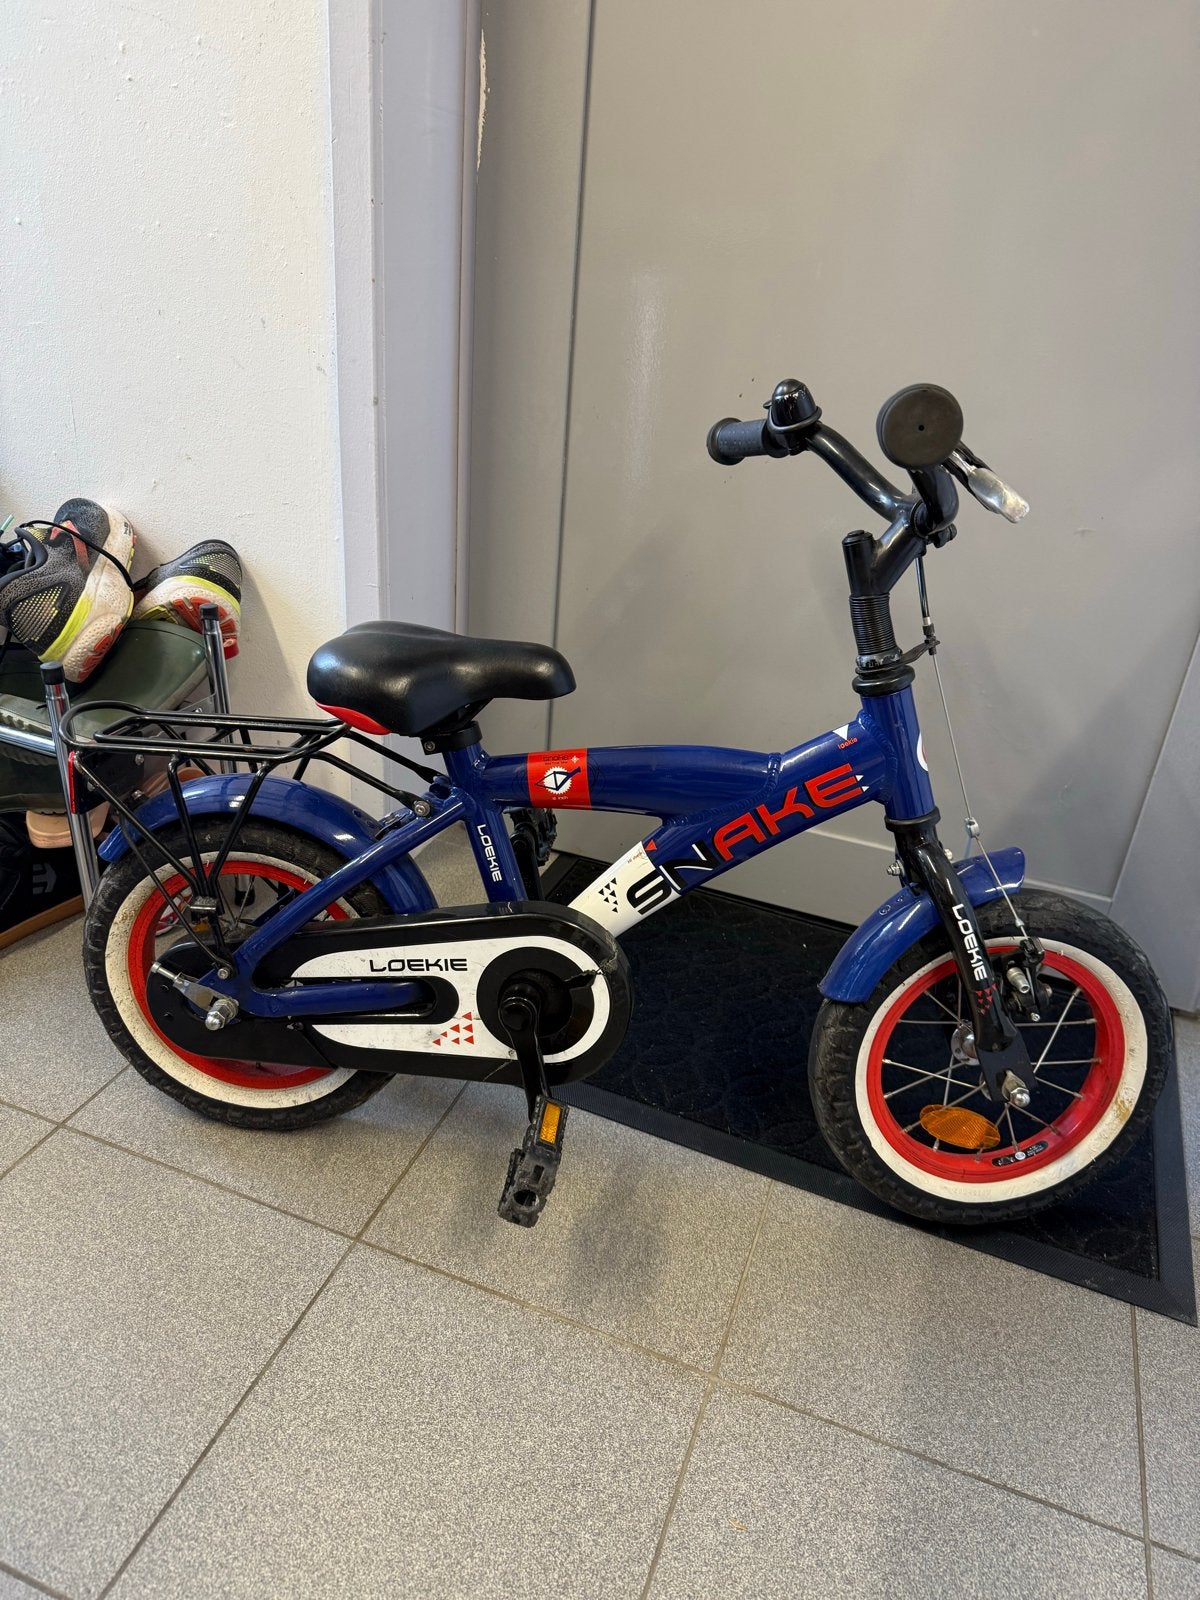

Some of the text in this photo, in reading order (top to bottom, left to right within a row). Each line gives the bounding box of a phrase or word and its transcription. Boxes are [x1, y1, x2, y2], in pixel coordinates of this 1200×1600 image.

[477, 824, 503, 882] LOEKIE
[626, 763, 862, 916] SNAKE
[369, 958, 468, 973] LOEKIE
[951, 903, 988, 982] LOEKIE
